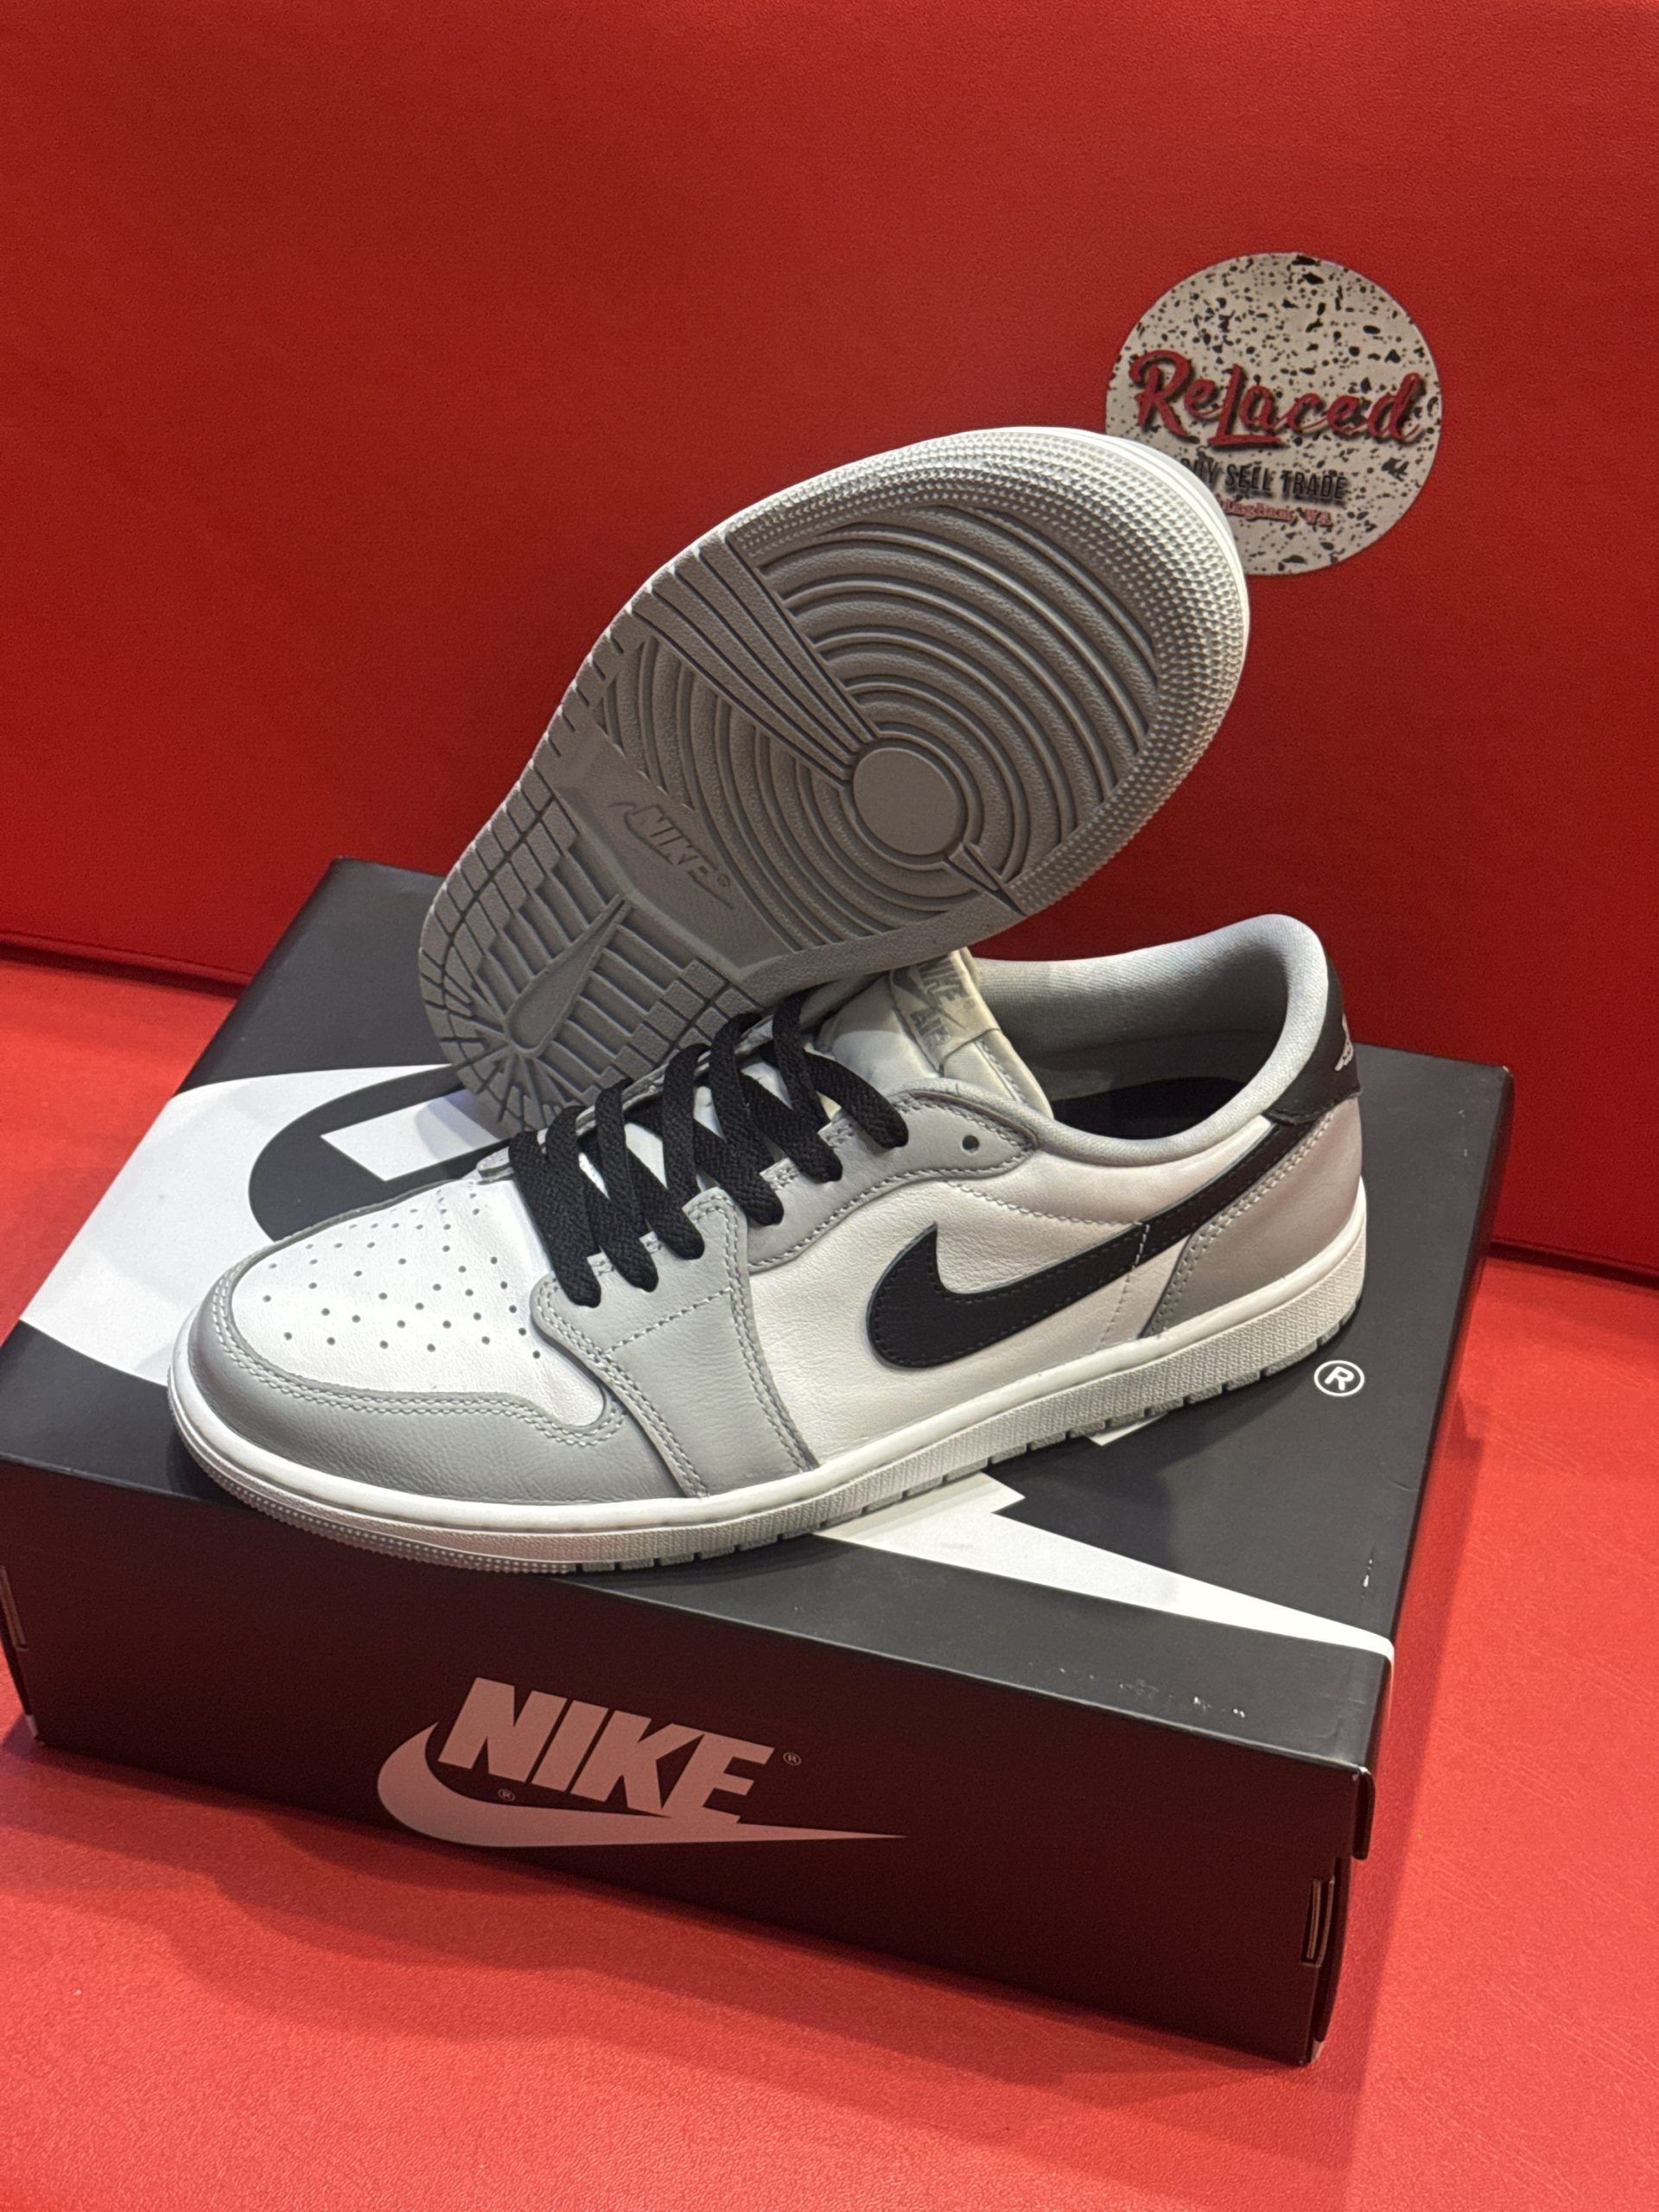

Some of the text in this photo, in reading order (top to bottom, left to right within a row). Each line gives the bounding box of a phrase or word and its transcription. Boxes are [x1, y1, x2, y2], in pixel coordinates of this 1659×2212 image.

[1225, 463, 1272, 492] SELL
[1281, 469, 1346, 500] TRADE
[631, 804, 720, 875] NIKE
[437, 1676, 776, 1824] NIKE
